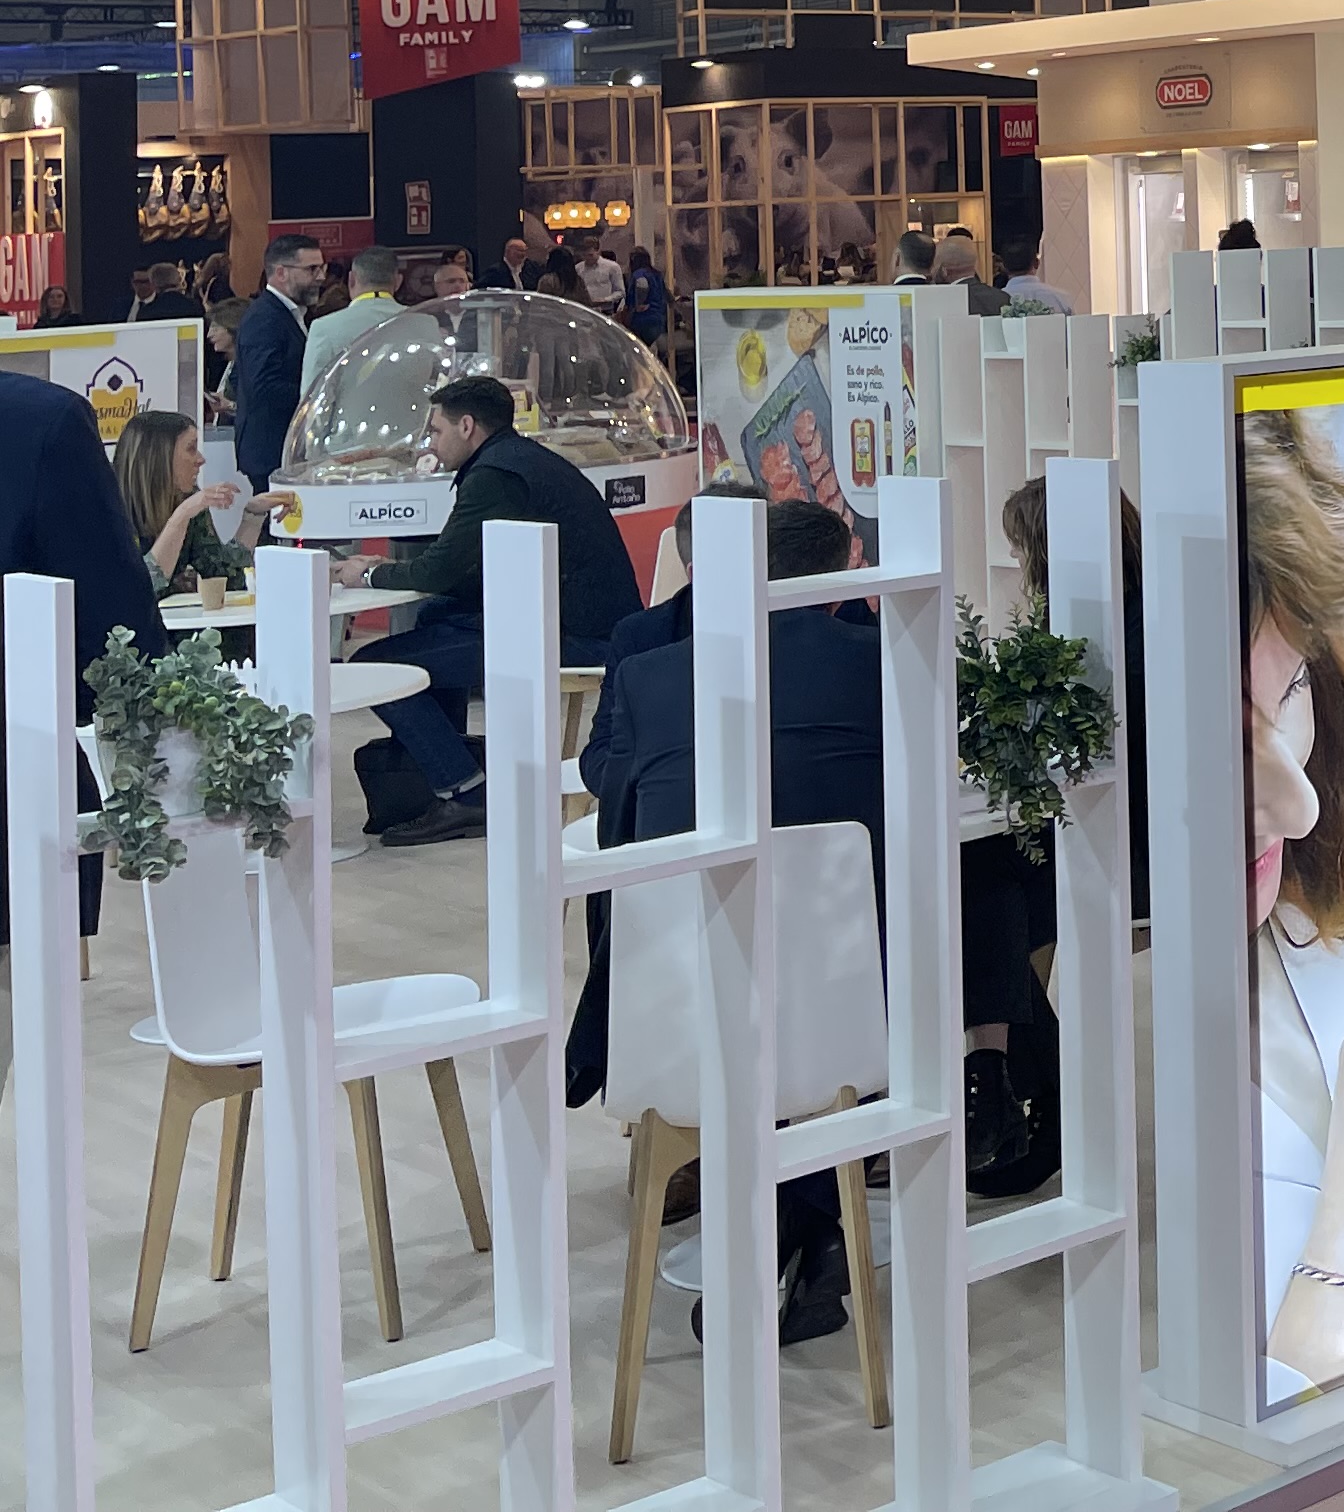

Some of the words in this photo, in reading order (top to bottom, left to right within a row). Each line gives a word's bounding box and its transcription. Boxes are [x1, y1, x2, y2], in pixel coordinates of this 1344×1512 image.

[399, 29, 473, 46] FAMILY
[1163, 83, 1203, 101] NOEL
[1004, 120, 1033, 139] GAM
[0, 233, 49, 303] GAM
[846, 365, 855, 375] Es
[856, 365, 865, 375] de
[847, 392, 856, 402] Es
[857, 392, 880, 406] Alpico.
